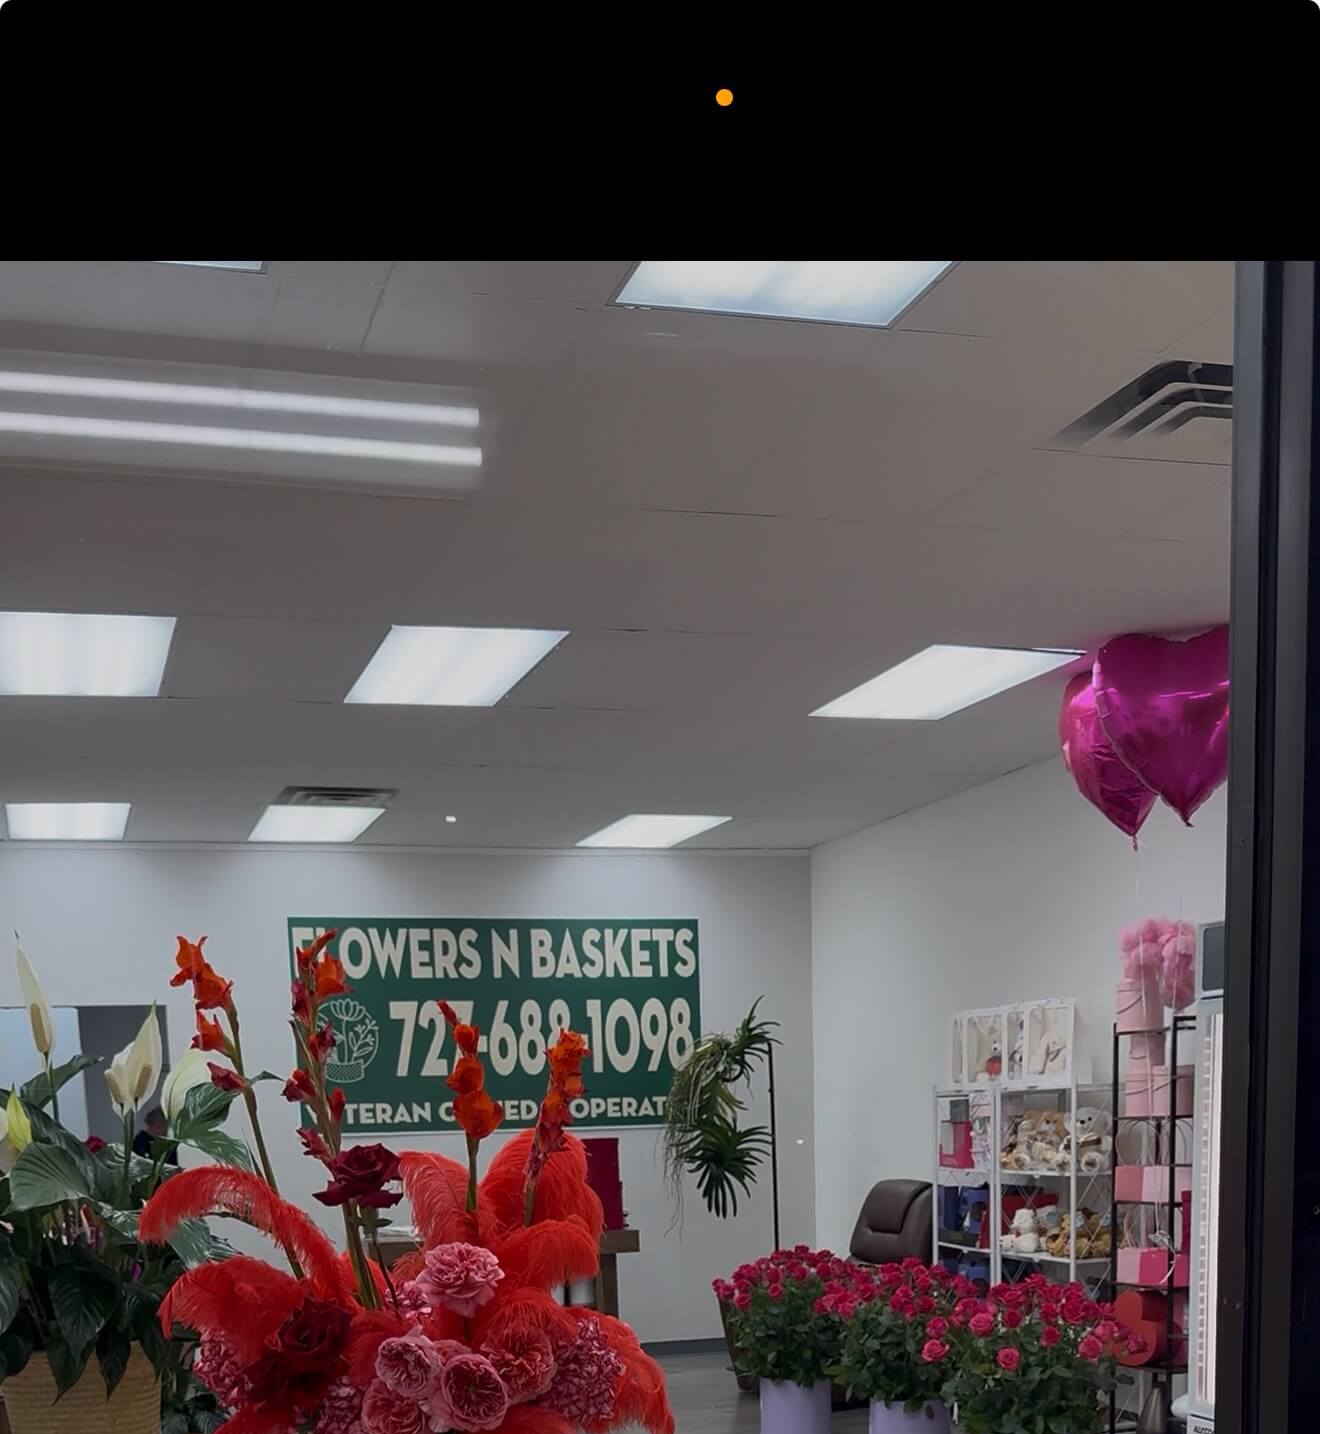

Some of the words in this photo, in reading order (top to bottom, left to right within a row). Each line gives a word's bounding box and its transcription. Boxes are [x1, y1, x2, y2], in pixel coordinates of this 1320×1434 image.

[491, 928, 520, 978] N
[530, 928, 697, 978] BASKETS
[306, 1102, 431, 1125] TERAN
[569, 1095, 667, 1119] OPERAT
